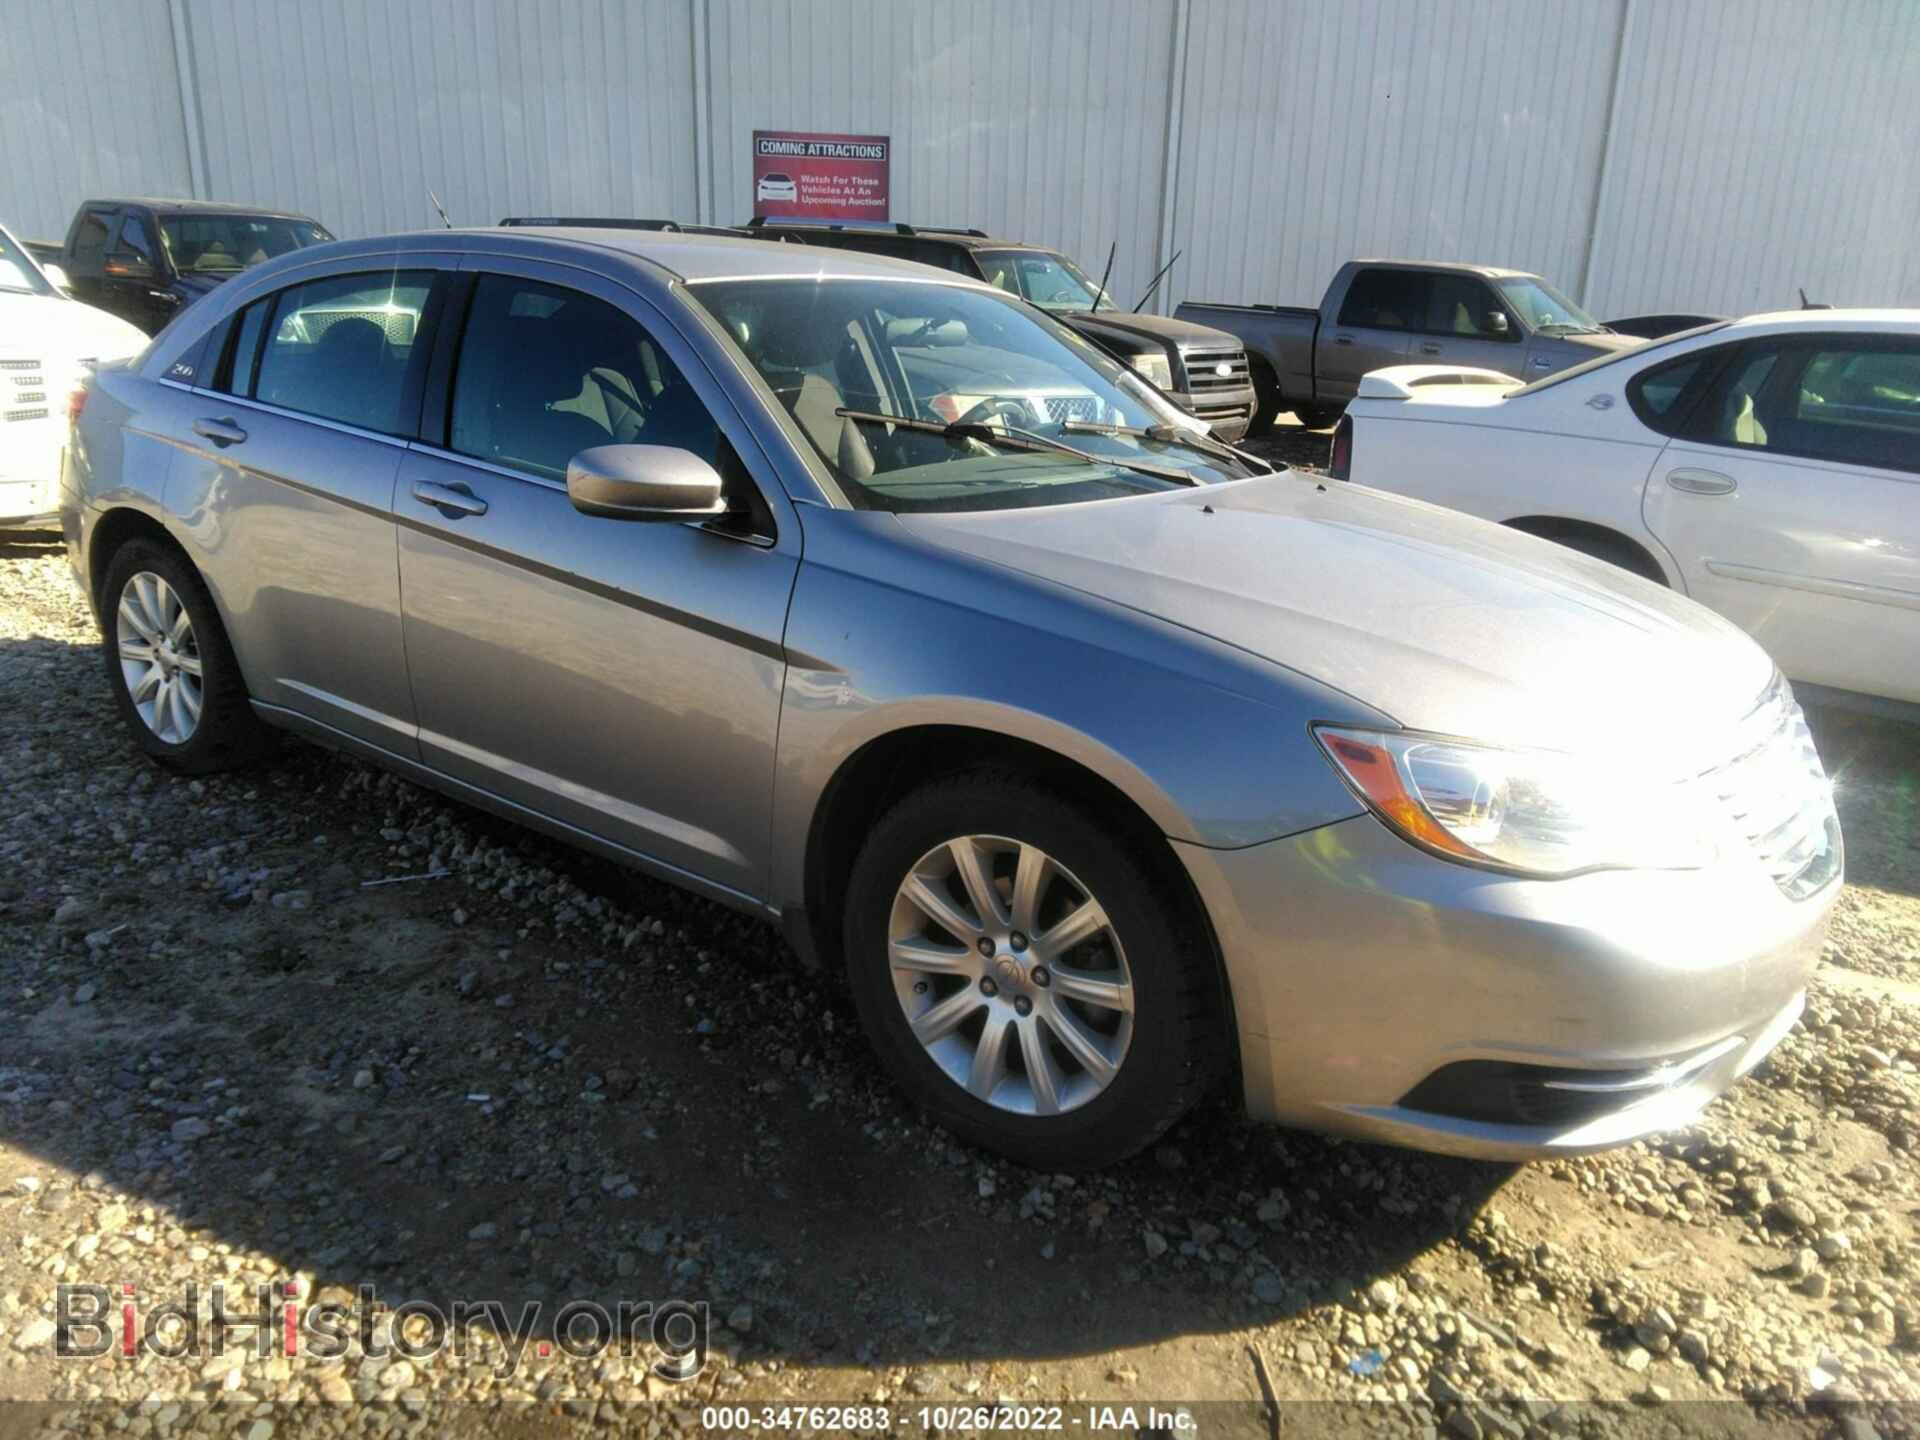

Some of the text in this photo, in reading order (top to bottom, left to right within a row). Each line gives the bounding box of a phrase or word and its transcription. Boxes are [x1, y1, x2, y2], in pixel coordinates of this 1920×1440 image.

[761, 141, 882, 158] COMING ATTRACTIONS
[800, 175, 879, 186] Watch For These
[801, 185, 872, 196] Vehicles At An
[801, 195, 886, 207] Upcoming Auction!
